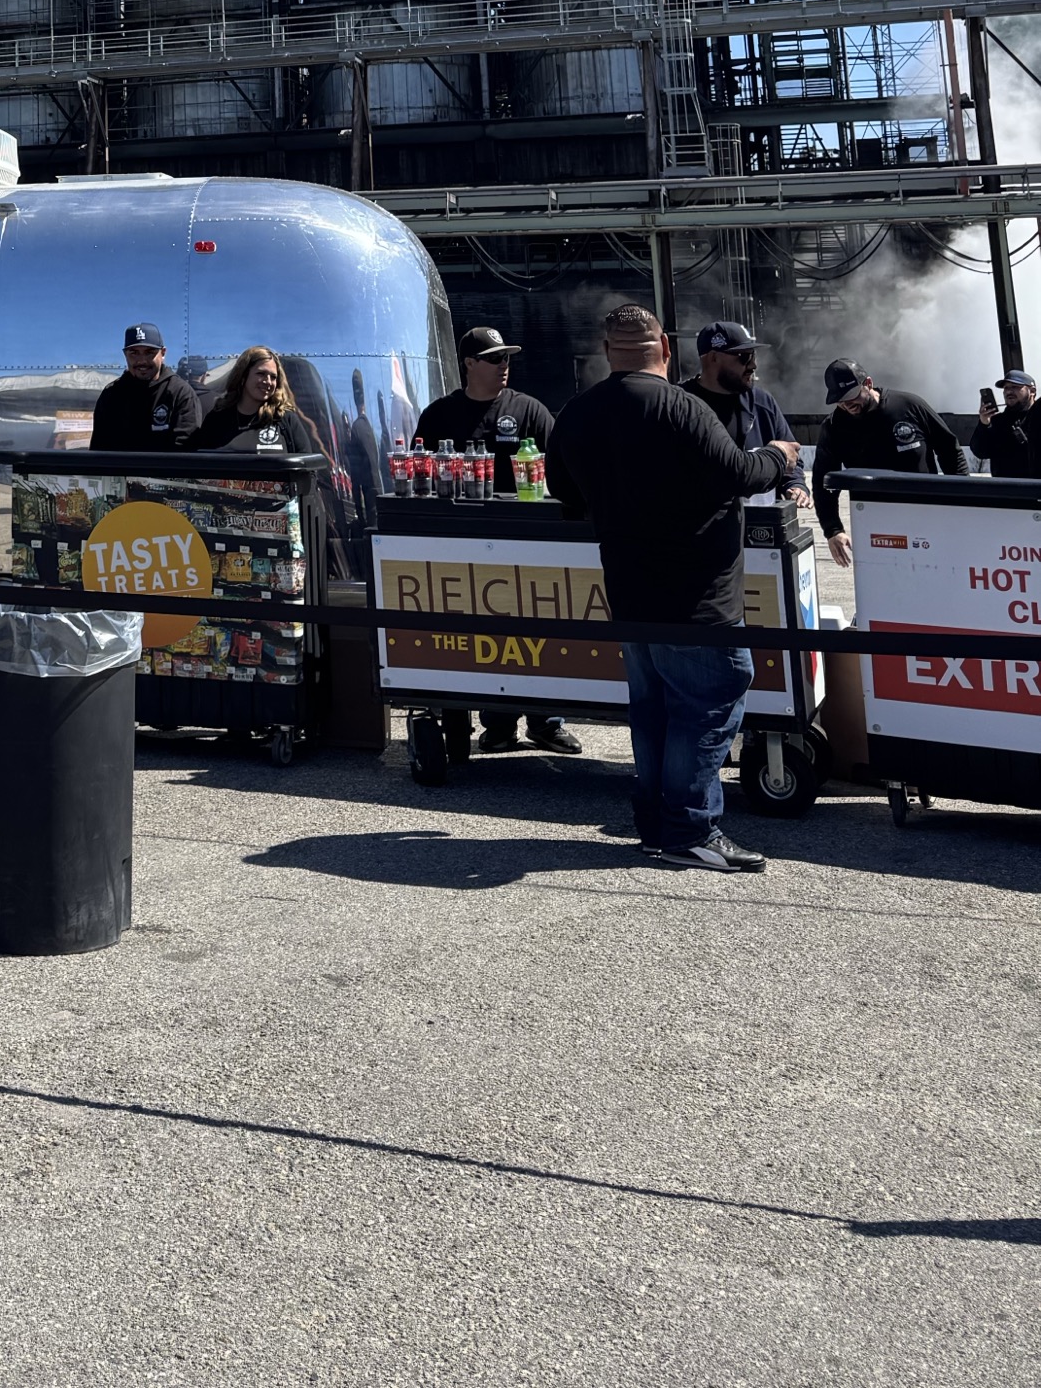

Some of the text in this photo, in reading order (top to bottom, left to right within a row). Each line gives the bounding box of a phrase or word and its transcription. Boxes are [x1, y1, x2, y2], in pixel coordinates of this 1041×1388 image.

[89, 533, 193, 574] TASTY
[999, 546, 1041, 563] JOIN
[97, 567, 199, 594] TREATS
[969, 567, 1031, 593] HOT
[1008, 600, 1041, 625] CL
[432, 634, 548, 668] THE DAY
[906, 655, 1041, 697] EXTR
